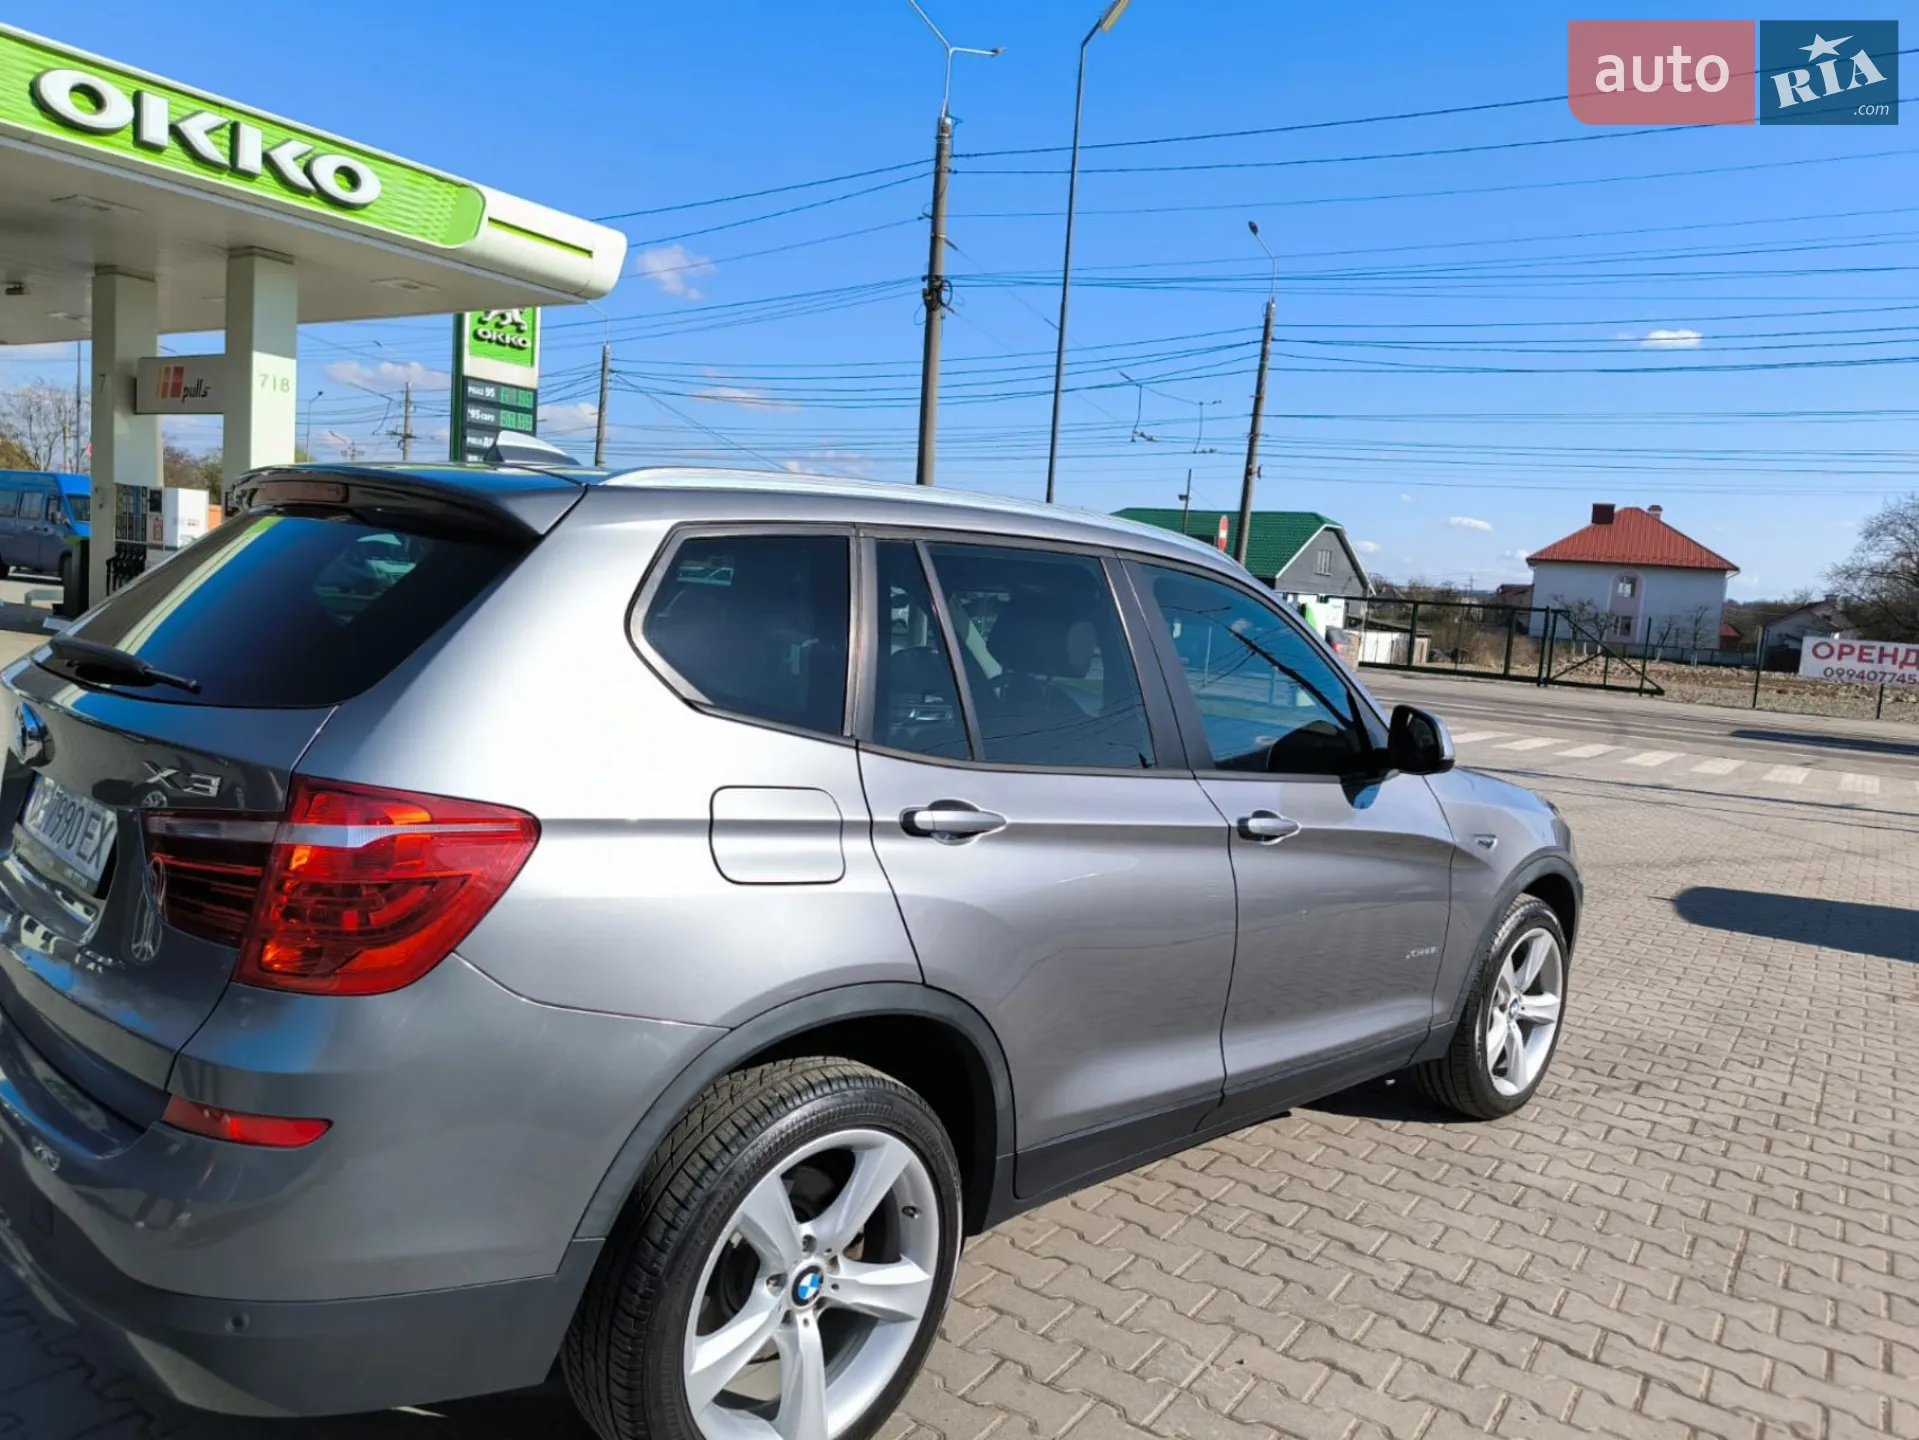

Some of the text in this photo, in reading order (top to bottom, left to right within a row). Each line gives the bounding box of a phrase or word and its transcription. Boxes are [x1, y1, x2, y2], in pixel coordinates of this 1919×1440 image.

[30, 68, 382, 209] OKKO
[475, 327, 531, 349] OKKO
[181, 379, 211, 404] pulls
[1811, 641, 1919, 670] ОРЕНД
[1823, 667, 1919, 685] 099407745
[142, 761, 221, 797] X3
